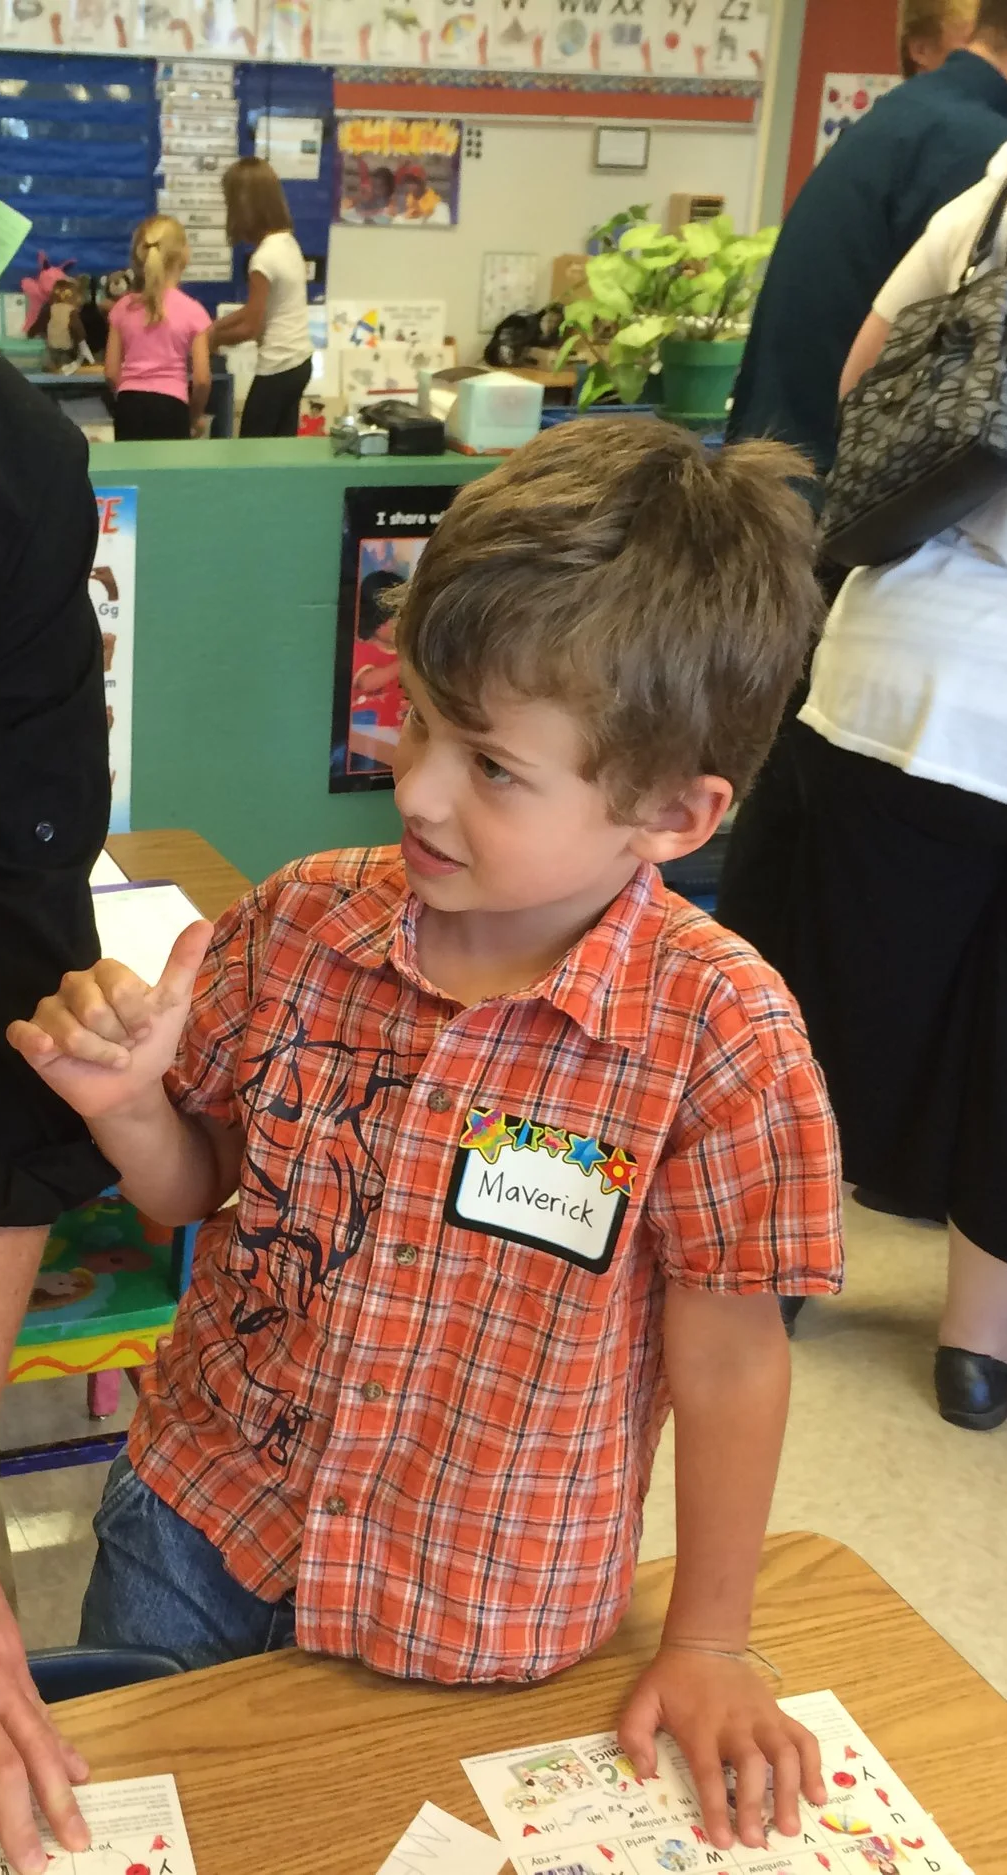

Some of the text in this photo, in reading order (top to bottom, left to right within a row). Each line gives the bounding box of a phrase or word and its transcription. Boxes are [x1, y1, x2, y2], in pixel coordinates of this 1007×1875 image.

[376, 511, 386, 526] I
[389, 511, 427, 526] share
[98, 603, 120, 618] Gg
[477, 1169, 594, 1229] Maverick
[635, 1804, 649, 1815] sh
[586, 1813, 603, 1825] wh
[630, 1816, 668, 1830] siblings
[541, 1822, 555, 1833] ch
[625, 1834, 657, 1848] world
[531, 1854, 562, 1867] x-ray
[748, 1858, 793, 1873] rainbow
